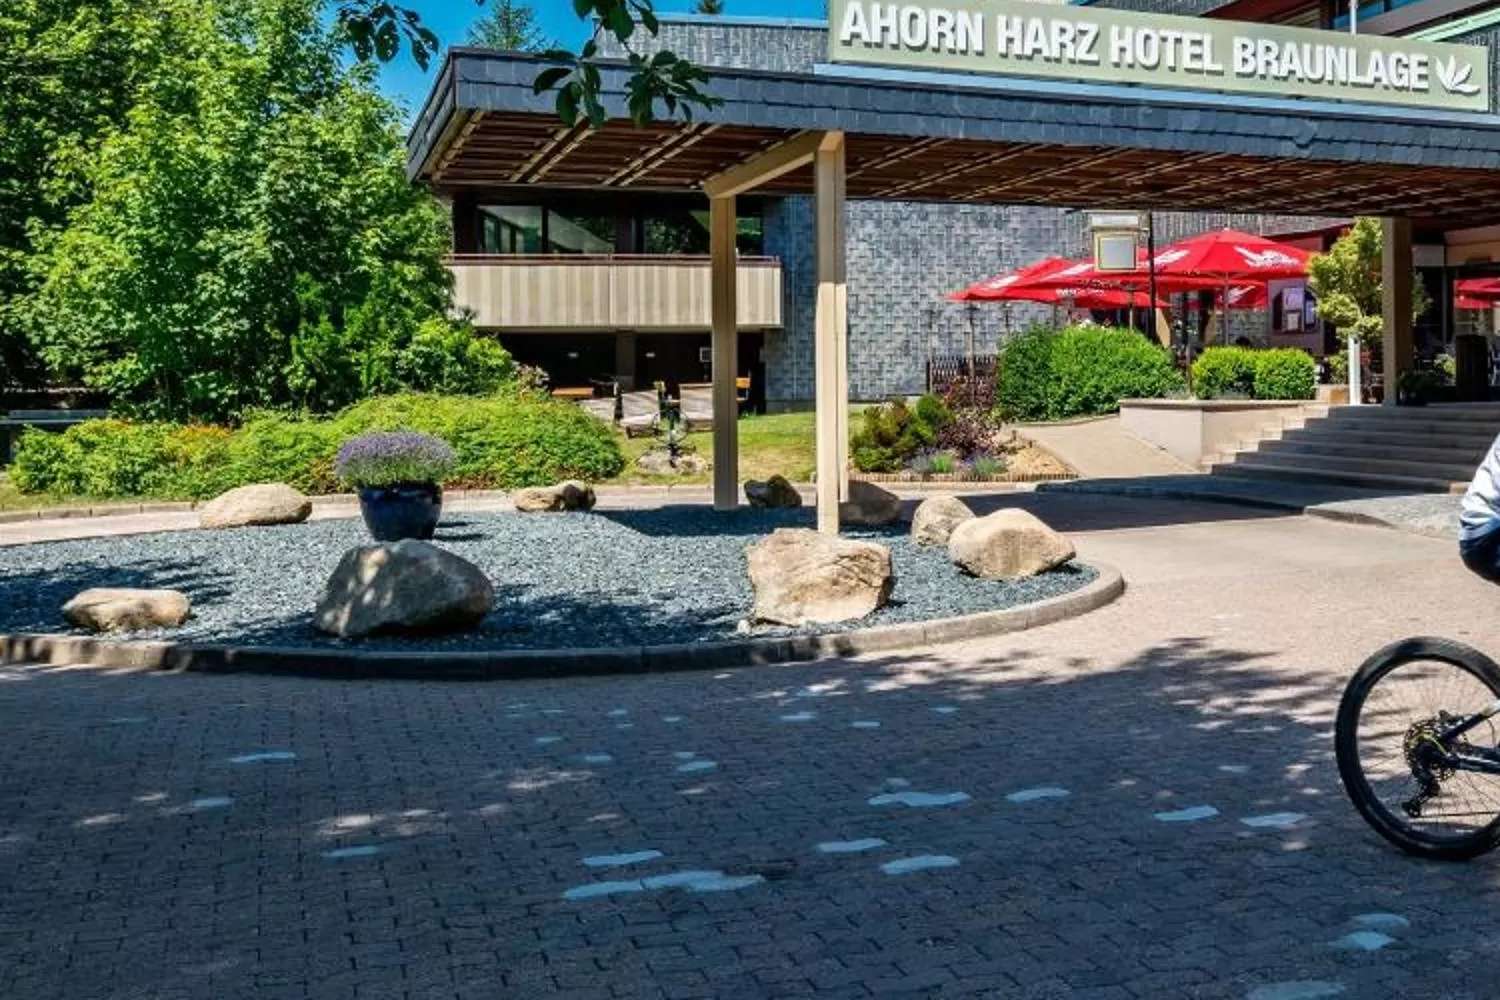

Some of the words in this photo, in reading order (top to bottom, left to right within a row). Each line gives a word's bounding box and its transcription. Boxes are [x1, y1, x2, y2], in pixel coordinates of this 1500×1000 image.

[840, 0, 985, 54] AHORN
[996, 15, 1100, 65] HARZ
[1109, 25, 1224, 76] HOTEL
[1232, 36, 1430, 93] BRAUNLAGE
